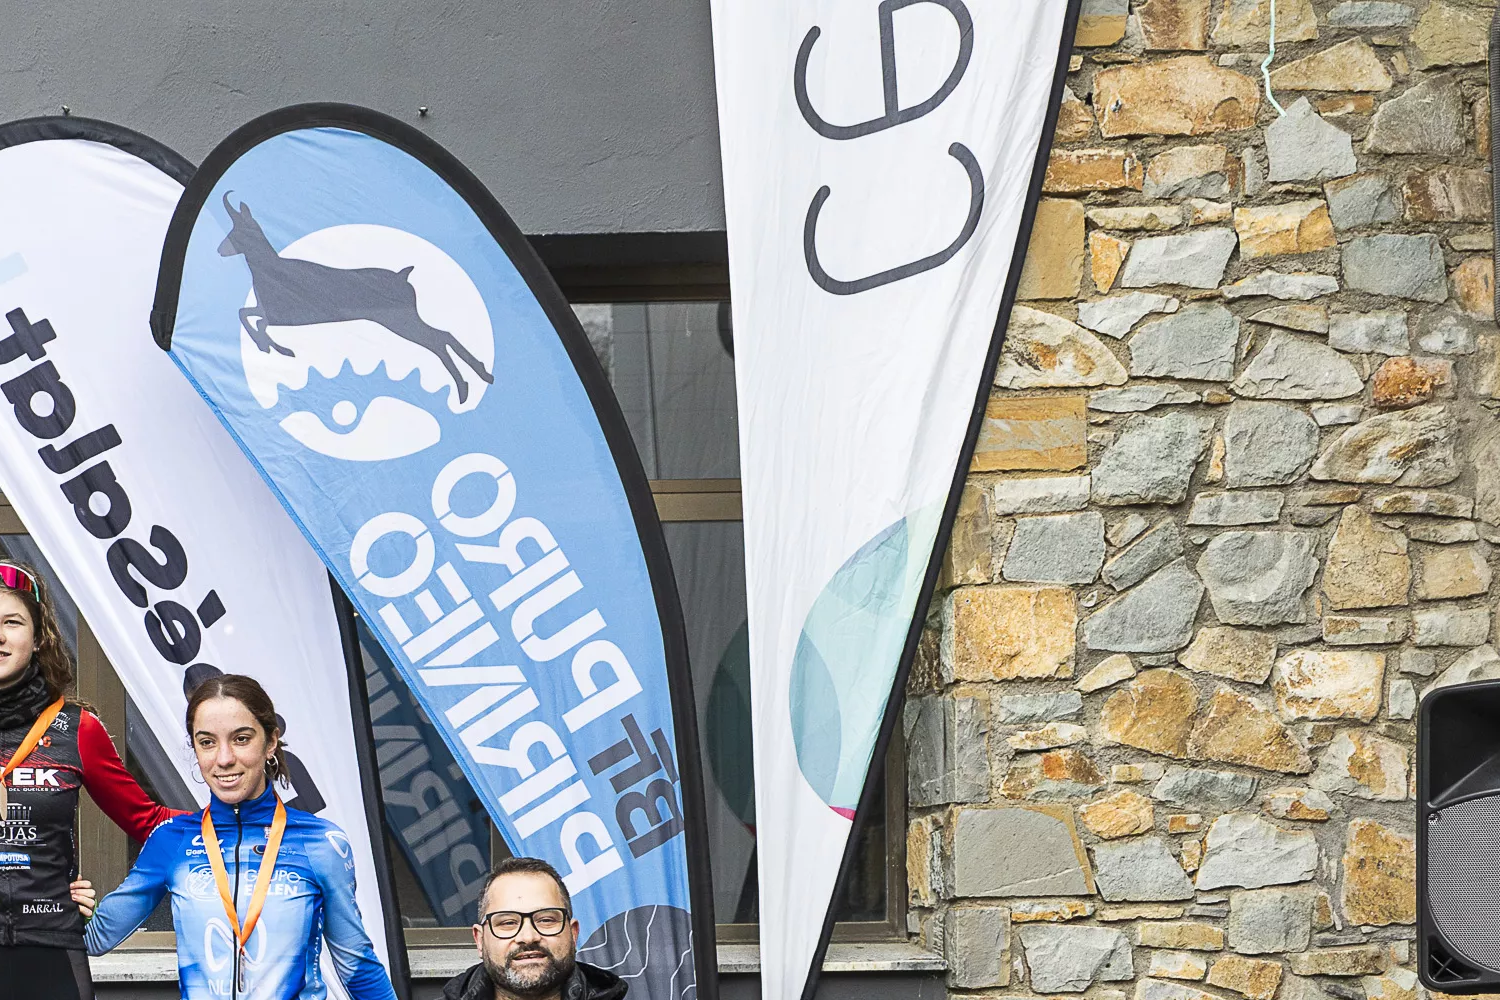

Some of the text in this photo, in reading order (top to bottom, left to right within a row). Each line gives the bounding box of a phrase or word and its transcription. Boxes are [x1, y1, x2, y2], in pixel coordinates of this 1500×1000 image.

[243, 868, 301, 883] GUPO
[243, 883, 299, 897] ELEN
[22, 902, 64, 914] BARRAL
